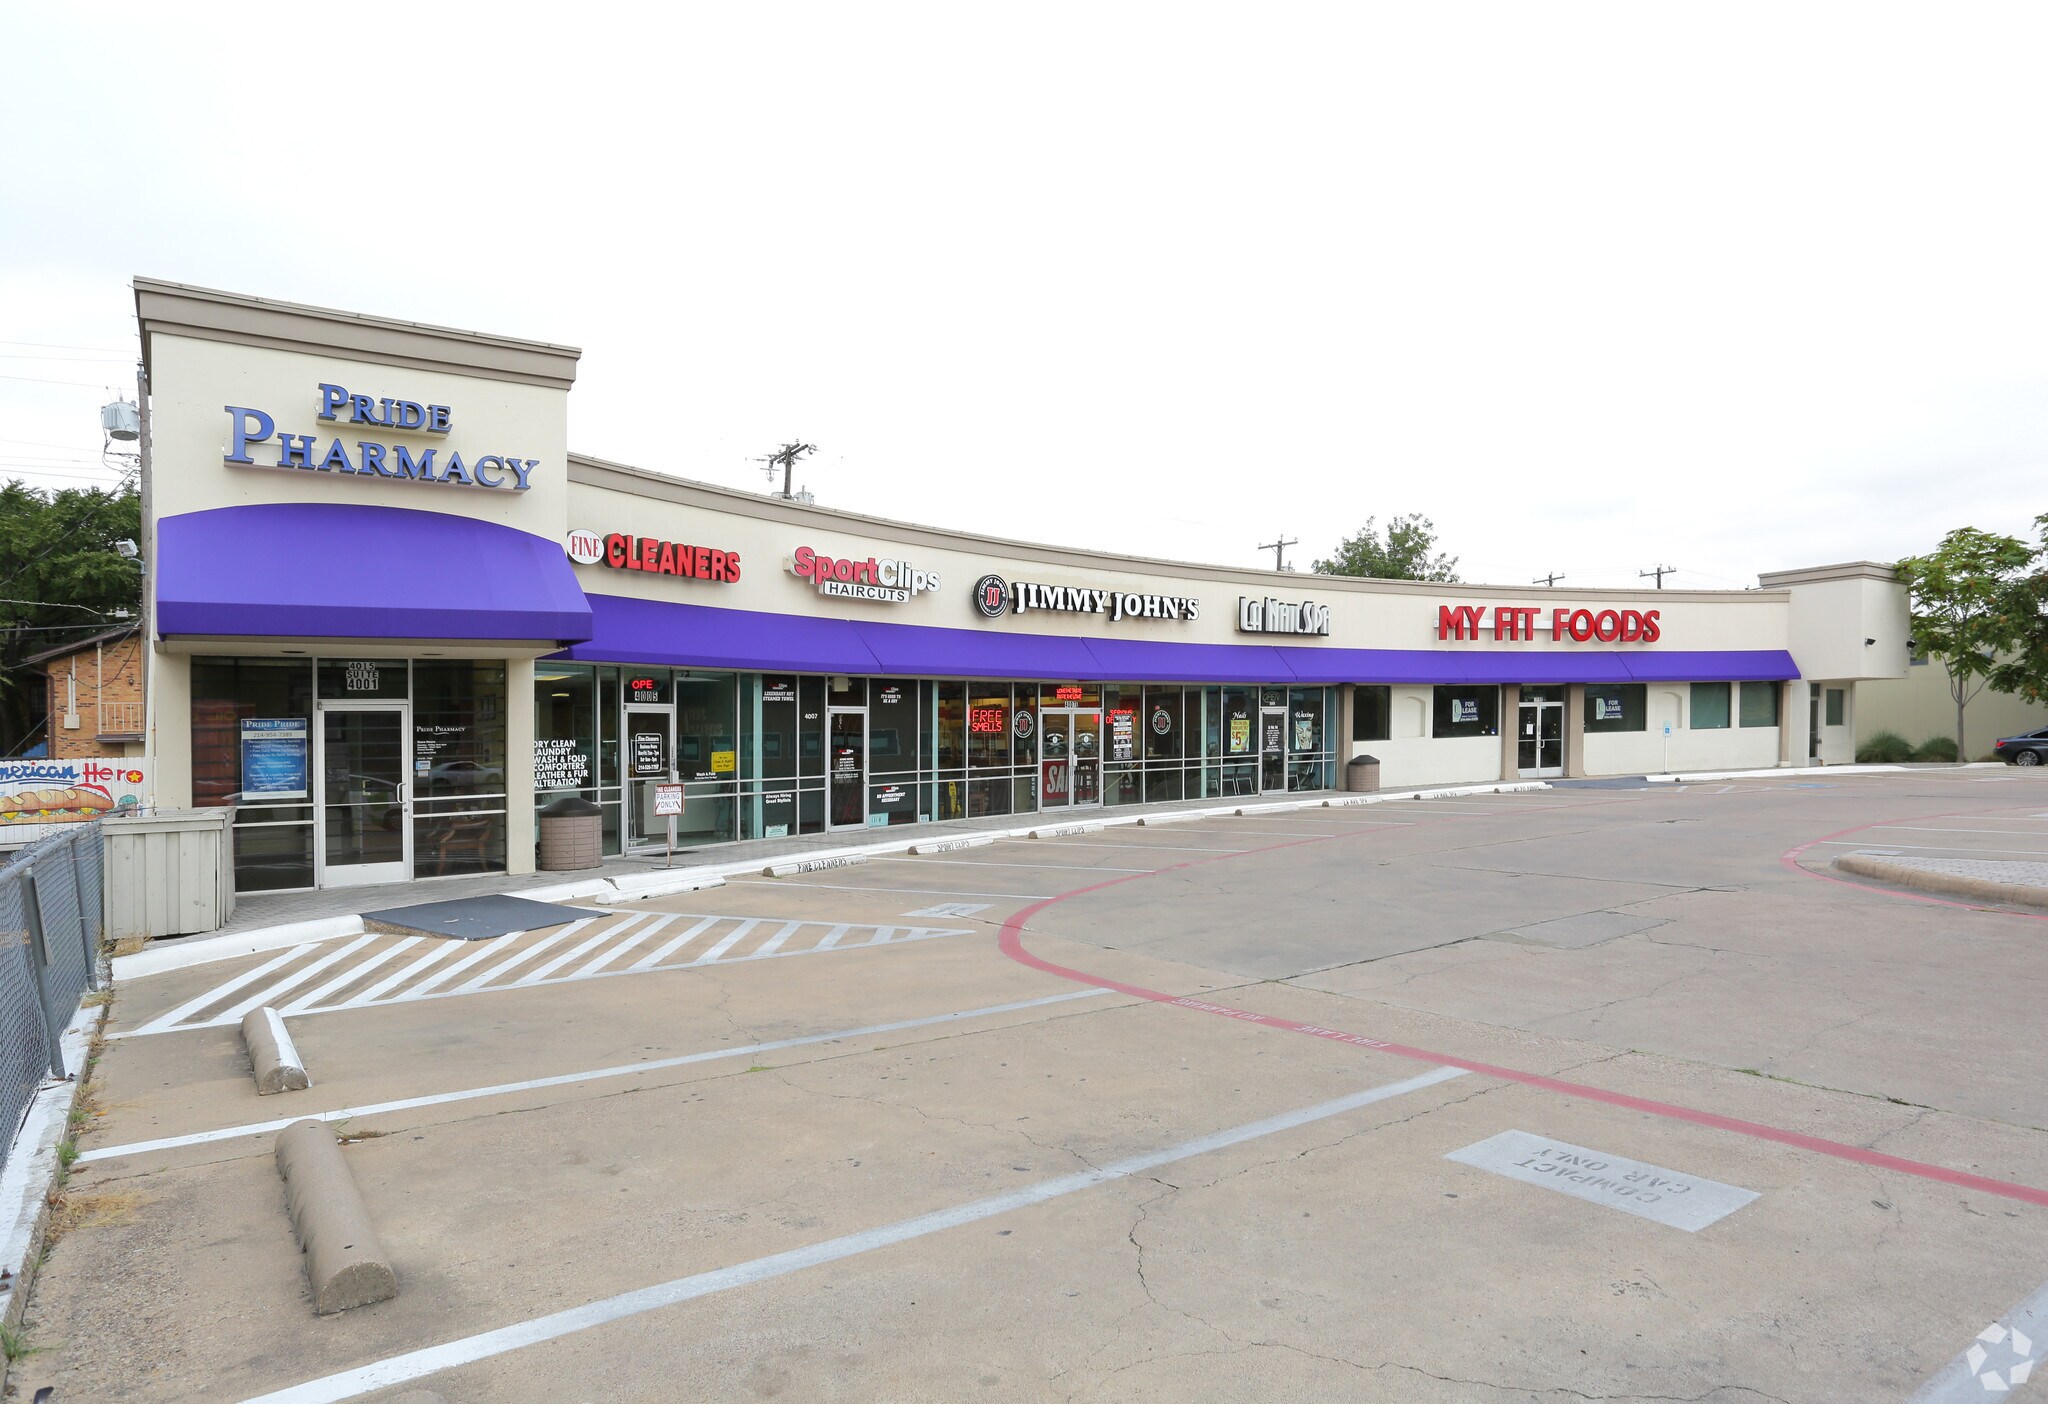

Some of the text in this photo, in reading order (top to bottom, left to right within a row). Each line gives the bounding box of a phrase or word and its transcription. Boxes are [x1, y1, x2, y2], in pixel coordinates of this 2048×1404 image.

[317, 382, 453, 434] PRIDE
[224, 405, 540, 490] PHARMACY
[571, 533, 741, 583] FINE CLEANERS
[829, 583, 905, 602] HAIRCUTS
[1012, 582, 1200, 622] JIMMY JOHN'S
[1438, 605, 1660, 642] MY FIT FOODS
[349, 662, 374, 670] 4015
[348, 679, 378, 690] 4001
[972, 710, 1003, 722] FREE
[1232, 711, 1247, 720] Nails
[1295, 710, 1314, 720] Waxing
[246, 720, 300, 728] PRIDE PRIDE
[972, 721, 1002, 732] SMELLS
[533, 740, 576, 748] DRY CLEAN
[534, 748, 571, 756] AUNDRY
[83, 763, 143, 783] Hero
[534, 771, 566, 779] EATHER
[534, 778, 581, 788] ALTERATION
[1294, 1025, 1392, 1048] FIRE LANE
[1532, 1149, 1691, 1195] CAR ONLY
[1512, 1159, 1662, 1203] COMPACT
